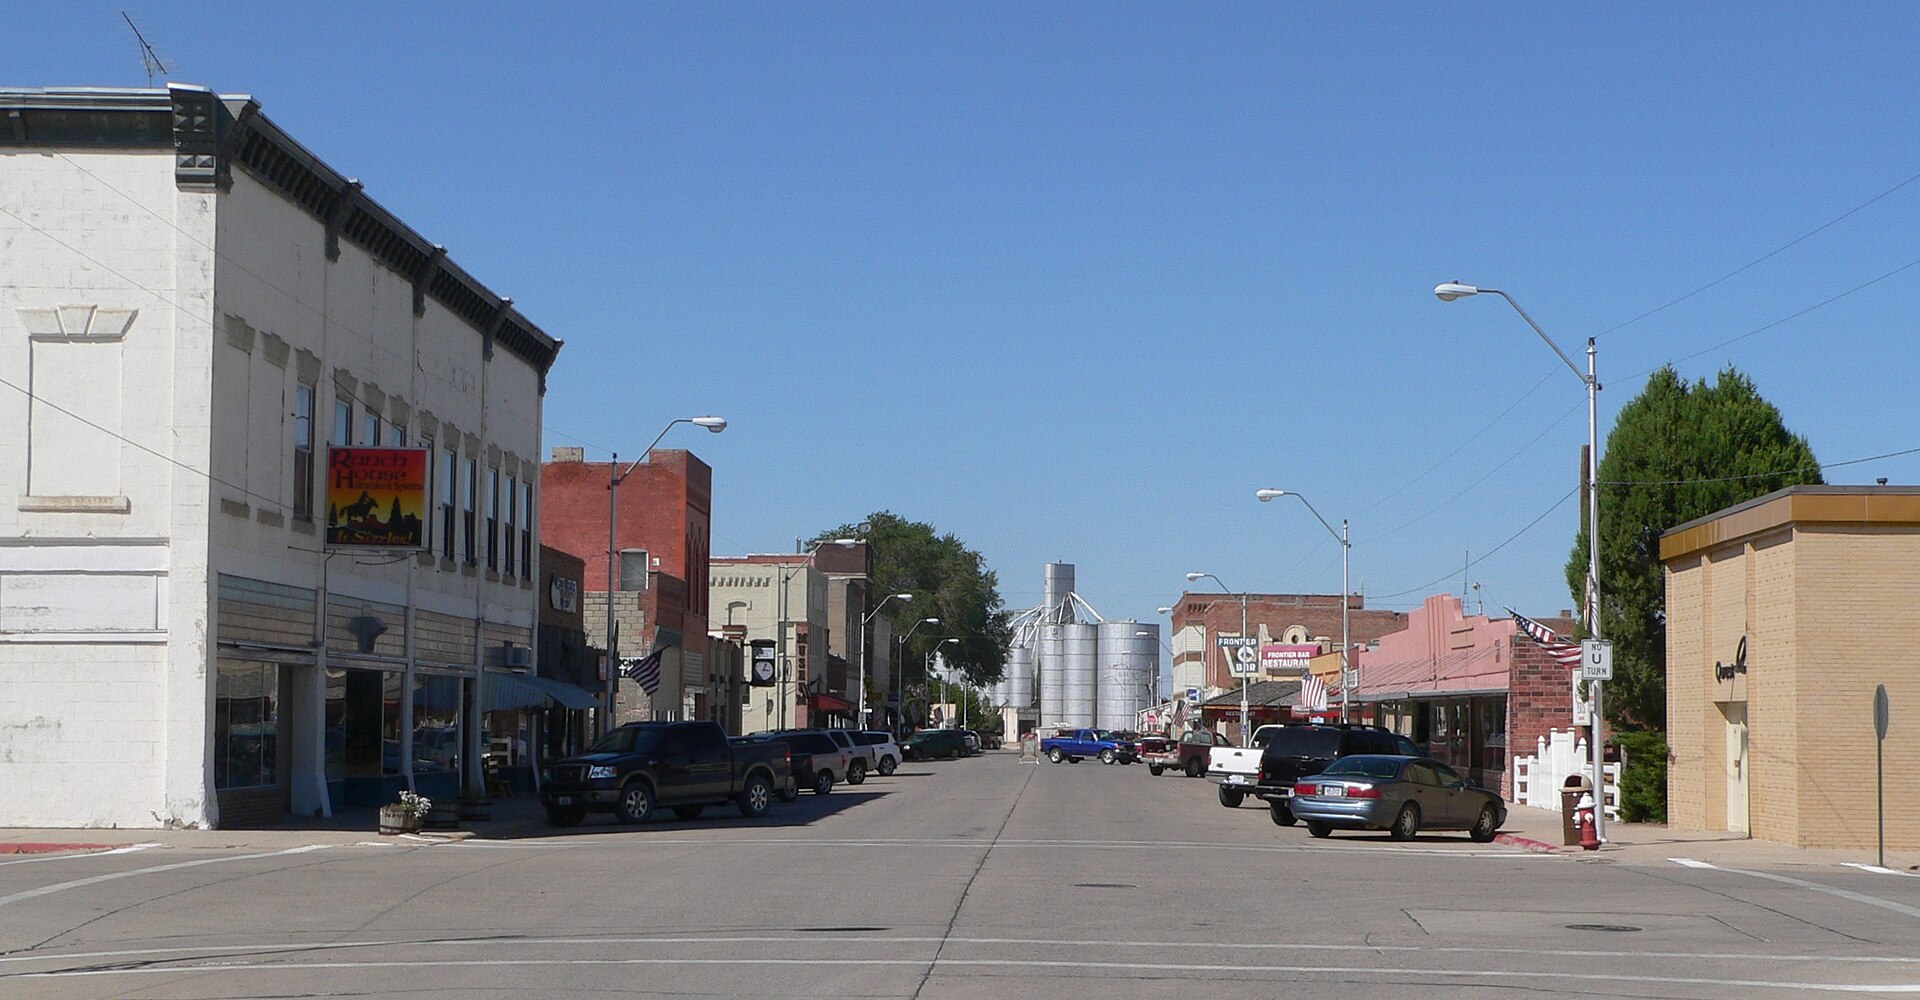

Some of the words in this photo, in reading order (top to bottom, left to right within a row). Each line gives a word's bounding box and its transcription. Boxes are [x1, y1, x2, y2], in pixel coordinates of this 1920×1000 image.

[333, 449, 408, 468] Ranch
[336, 469, 407, 489] House
[1591, 643, 1602, 651] NO
[1262, 658, 1310, 668] RESTAURAN
[1591, 653, 1602, 664] U
[1587, 667, 1607, 676] TURN
